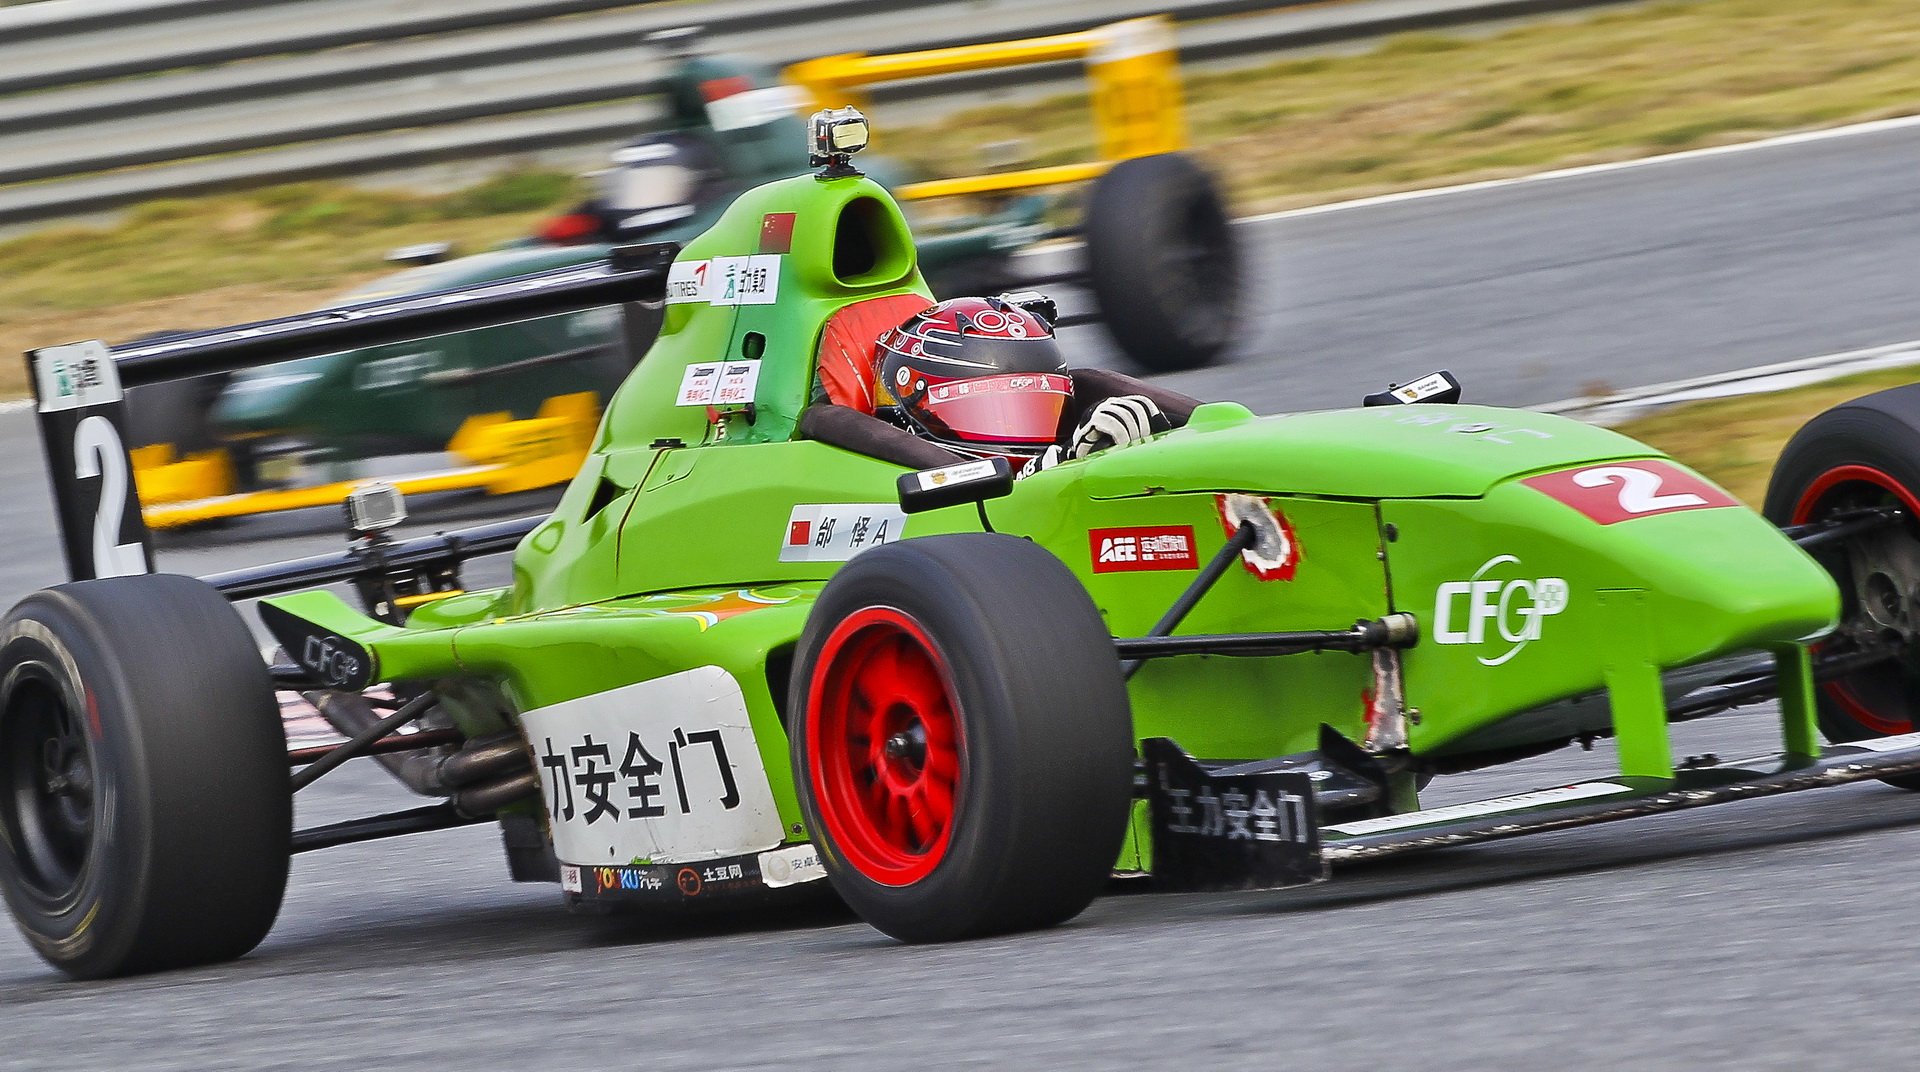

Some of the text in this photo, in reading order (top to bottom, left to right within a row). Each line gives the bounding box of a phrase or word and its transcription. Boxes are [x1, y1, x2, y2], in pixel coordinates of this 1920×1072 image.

[74, 415, 148, 580] 2
[1572, 466, 1709, 514] 2
[1099, 536, 1137, 562] AEE
[1432, 577, 1570, 645] CFGP
[1167, 785, 1309, 843] 王力安全门
[703, 864, 743, 883] 土豆网
